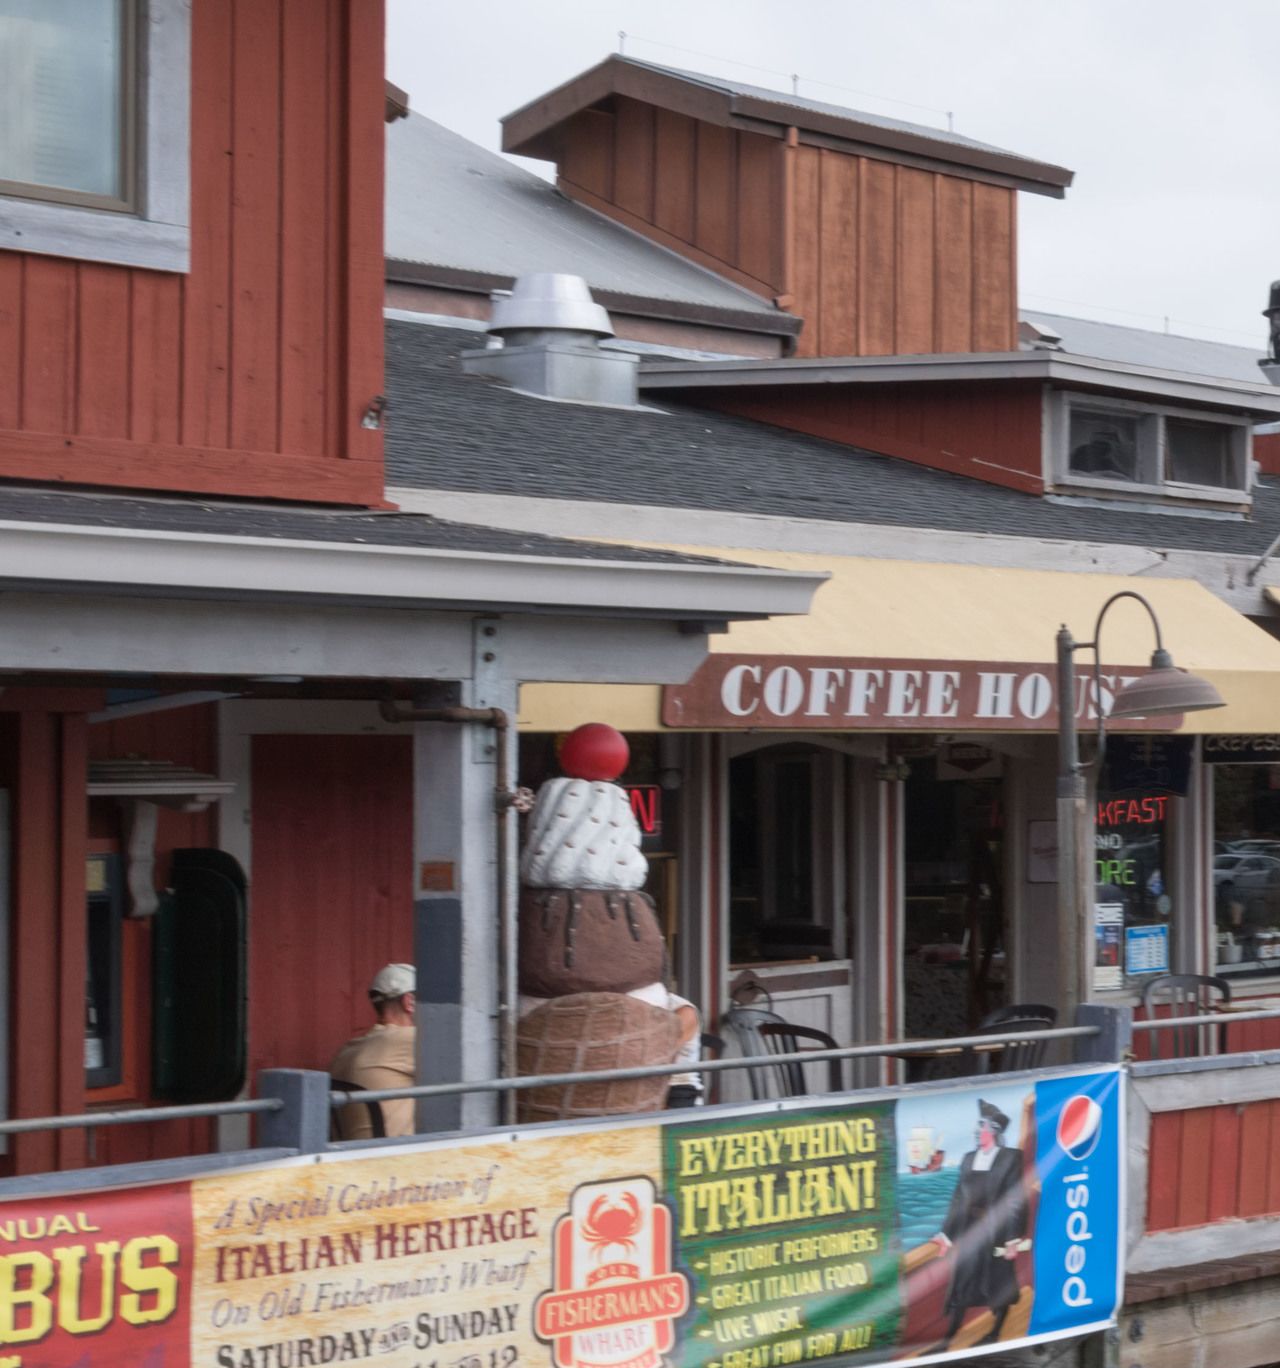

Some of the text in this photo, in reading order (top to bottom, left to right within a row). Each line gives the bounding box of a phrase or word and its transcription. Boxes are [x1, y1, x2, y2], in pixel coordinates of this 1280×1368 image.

[721, 664, 1147, 720] COFFEE HOS
[1093, 796, 1169, 826] KFAST
[680, 1117, 877, 1177] EVERYTHING
[213, 1164, 500, 1235] A Special Celebration of
[680, 1160, 877, 1237] ITALIAN!
[214, 1206, 538, 1283] ITALIAN HERITAGE
[710, 1227, 879, 1276] HISTORIC PERFORMERS
[1062, 1173, 1093, 1308] pepsi
[0, 1234, 180, 1344] BUS
[211, 1250, 537, 1328] On Old Fisherman's Wharf
[544, 1281, 681, 1330] FISHERMAN'S
[711, 1262, 869, 1310] GREAT ITALIAN FOOD
[378, 1324, 411, 1350] AND
[413, 1303, 520, 1350] SUNDAY
[578, 1323, 649, 1355] WHARF
[714, 1306, 804, 1342] LIVE MUSIC
[772, 1339, 803, 1366] FUN
[806, 1332, 838, 1359] FOR
[839, 1325, 872, 1352] ALL!
